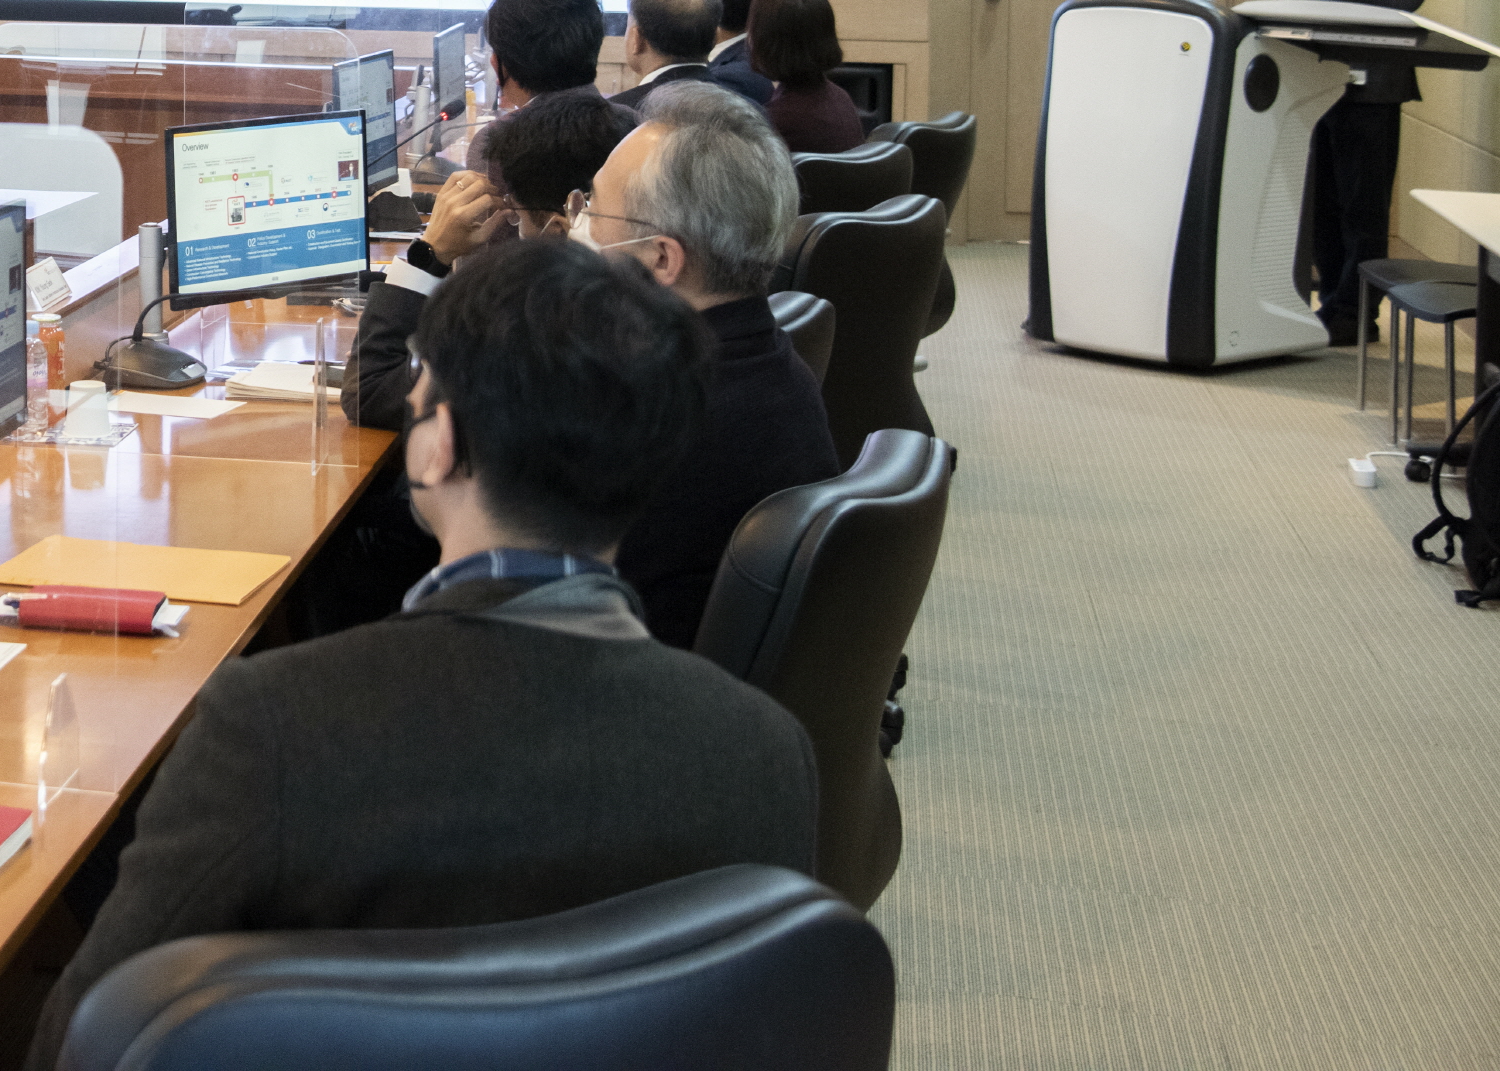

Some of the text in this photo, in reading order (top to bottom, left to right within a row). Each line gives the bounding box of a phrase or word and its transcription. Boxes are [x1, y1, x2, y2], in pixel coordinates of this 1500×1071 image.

[181, 141, 209, 152] Overview
[307, 229, 316, 239] 03
[247, 237, 257, 248] 02
[185, 246, 194, 257] 01
